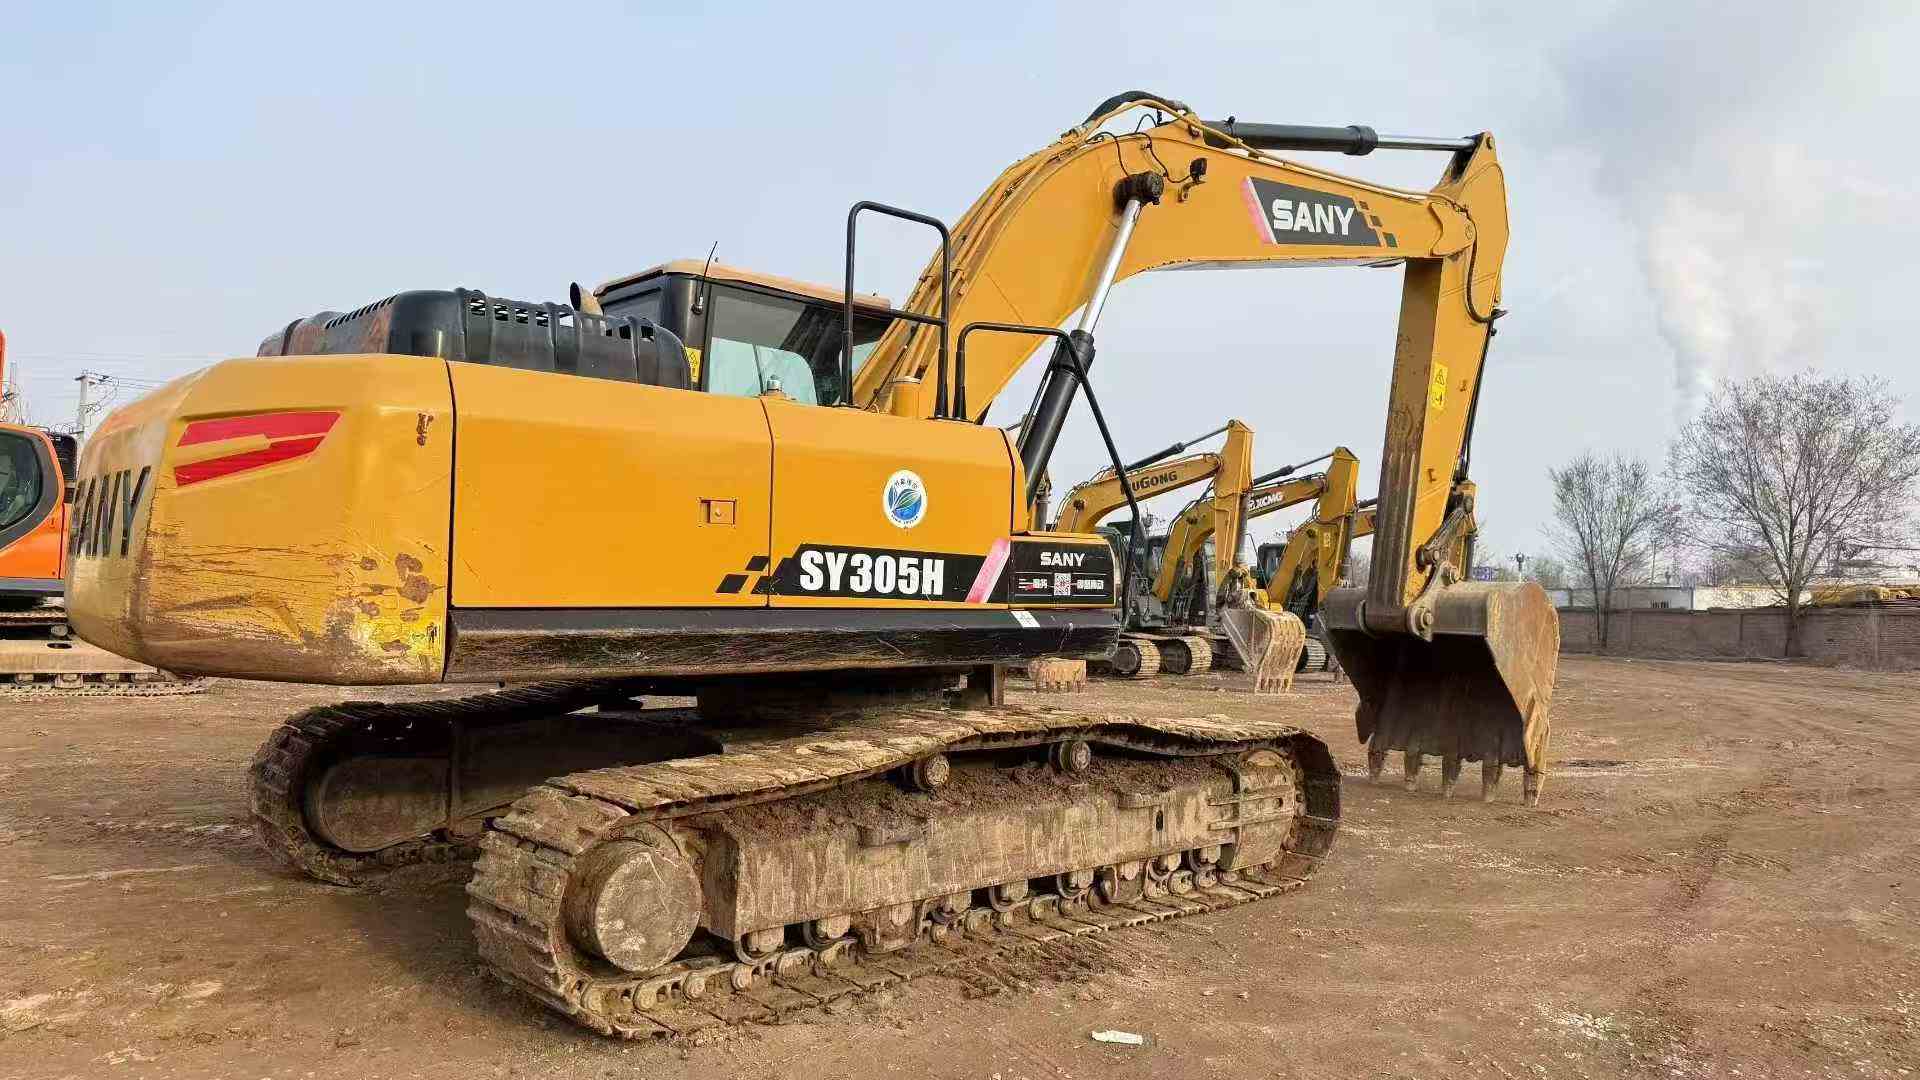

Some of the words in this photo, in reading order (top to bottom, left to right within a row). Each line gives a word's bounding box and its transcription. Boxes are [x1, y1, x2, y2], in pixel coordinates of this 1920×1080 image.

[1271, 198, 1355, 235] SANY
[1256, 491, 1283, 509] XCMG
[1040, 551, 1085, 567] SANY
[799, 550, 945, 596] SY305H
